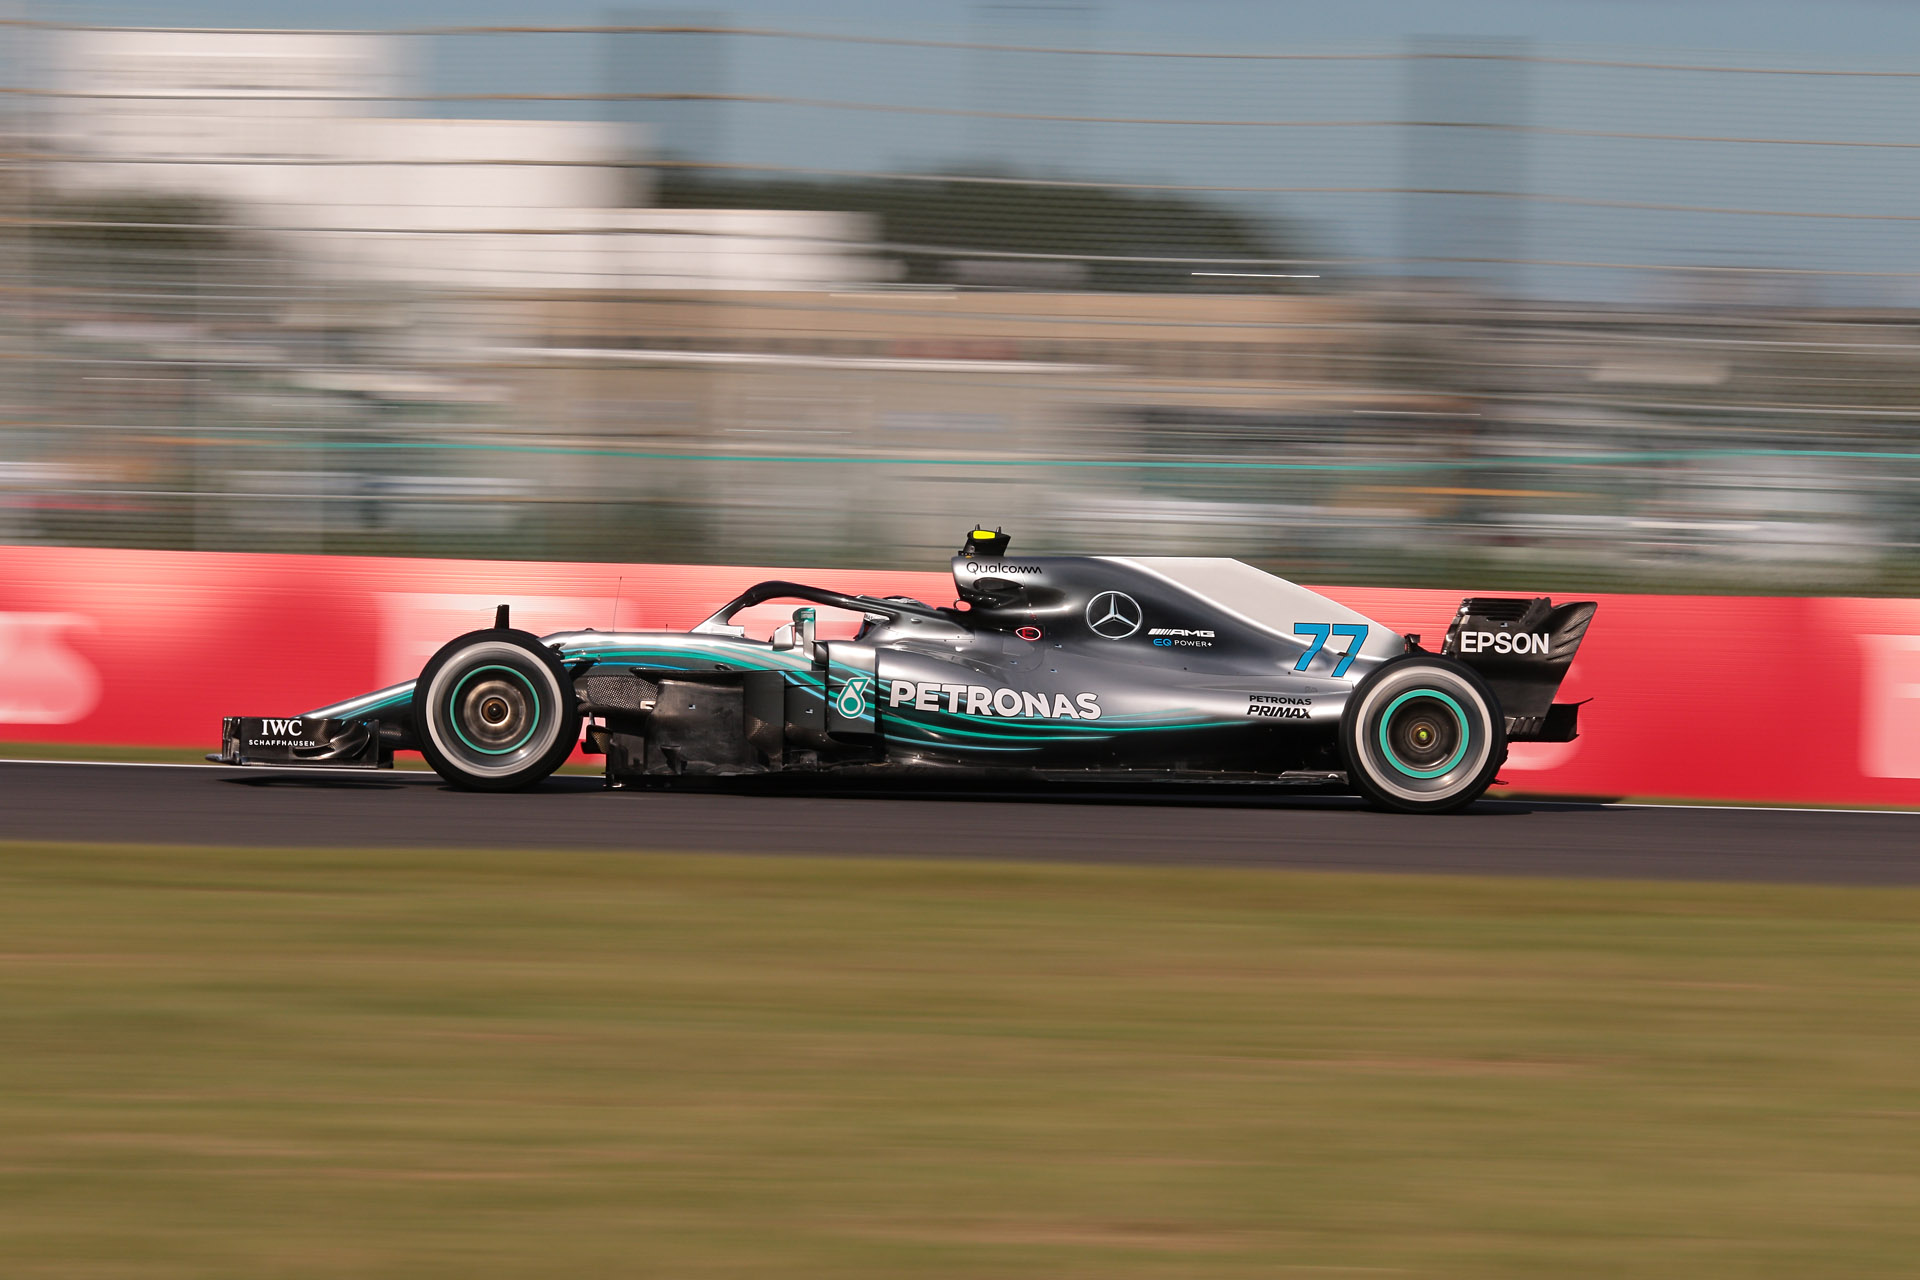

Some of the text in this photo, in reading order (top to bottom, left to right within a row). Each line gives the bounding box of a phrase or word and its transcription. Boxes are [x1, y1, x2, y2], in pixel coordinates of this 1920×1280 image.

[967, 562, 1042, 575] Qualcomm
[1170, 628, 1215, 637] AMG
[1153, 638, 1172, 647] EQ
[1461, 631, 1550, 655] EPSON
[1293, 622, 1369, 678] 77
[889, 680, 1102, 720] PETRONAS
[1249, 695, 1312, 706] PETRONAS
[1246, 705, 1311, 719] PRIMAX
[261, 719, 303, 737] IWC
[248, 739, 315, 747] SCHAFFHAUSEN
